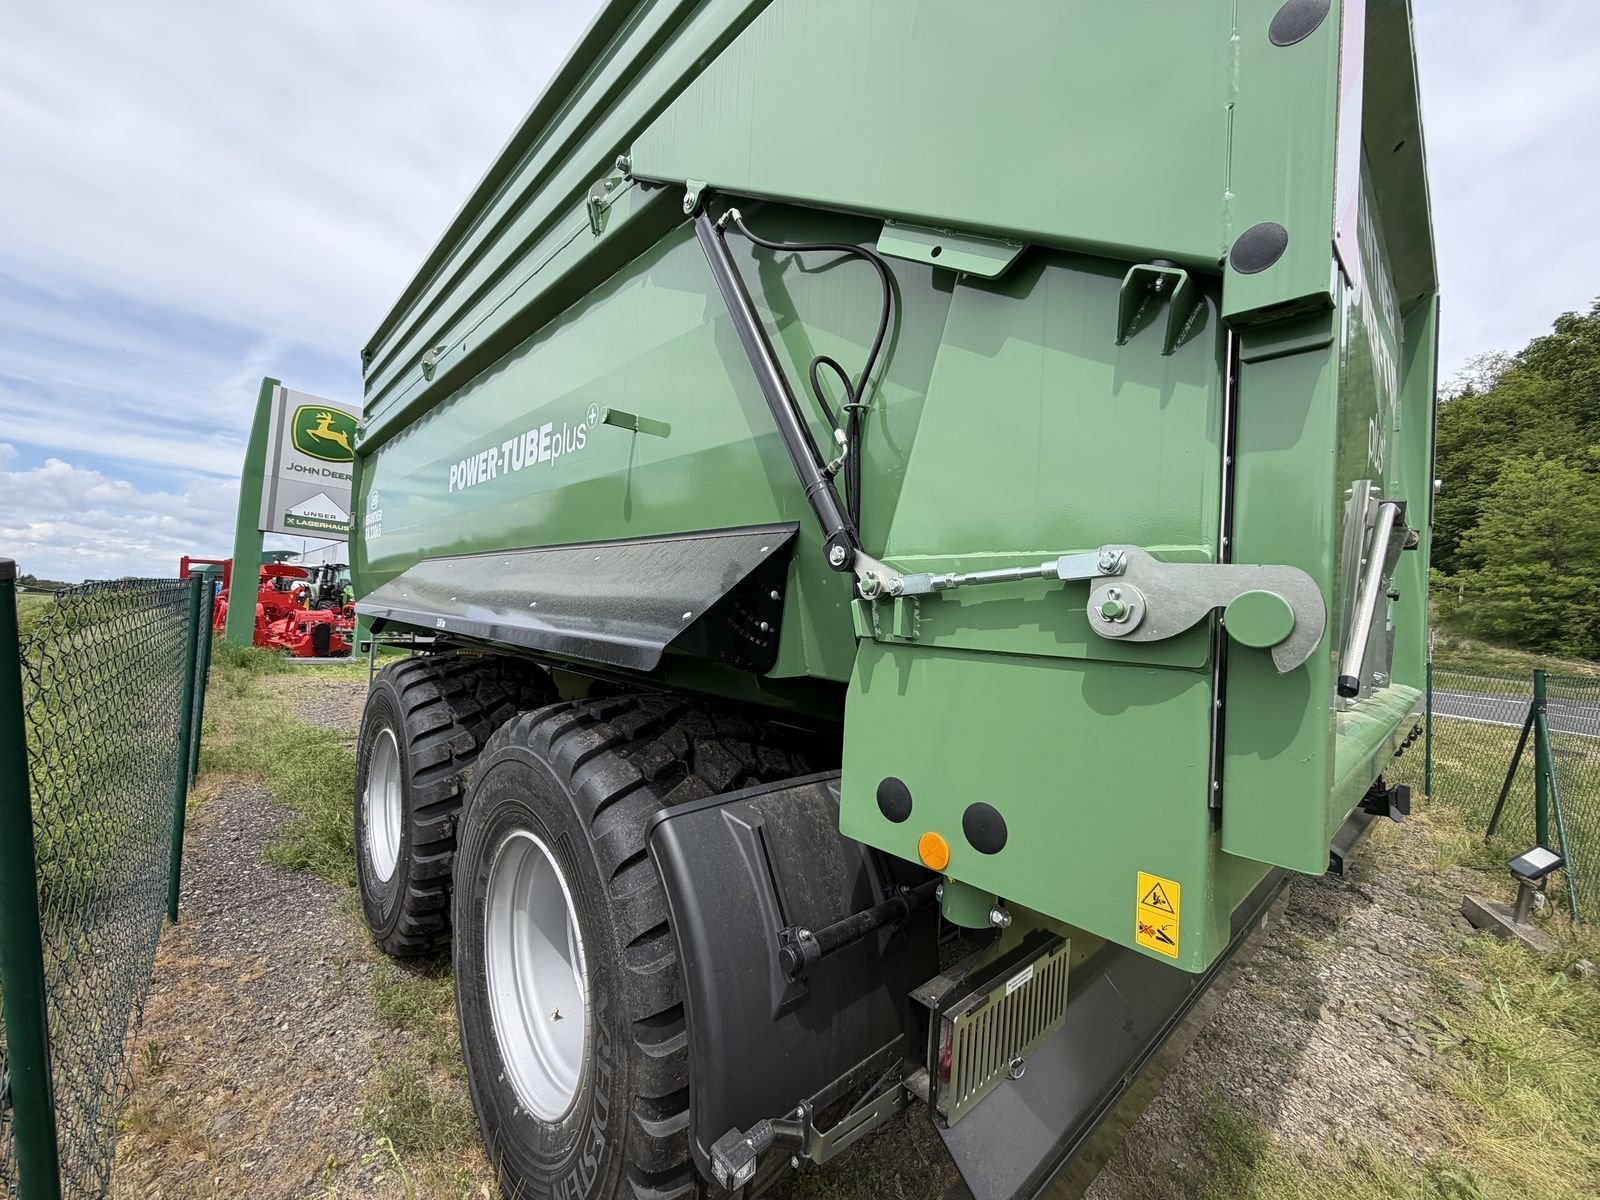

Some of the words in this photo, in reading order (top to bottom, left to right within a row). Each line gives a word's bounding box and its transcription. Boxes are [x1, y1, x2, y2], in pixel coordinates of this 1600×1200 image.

[286, 462, 320, 476] JOHN
[322, 468, 353, 481] DEER
[303, 510, 337, 520] UNSER
[296, 519, 350, 531] LAGERHAUS
